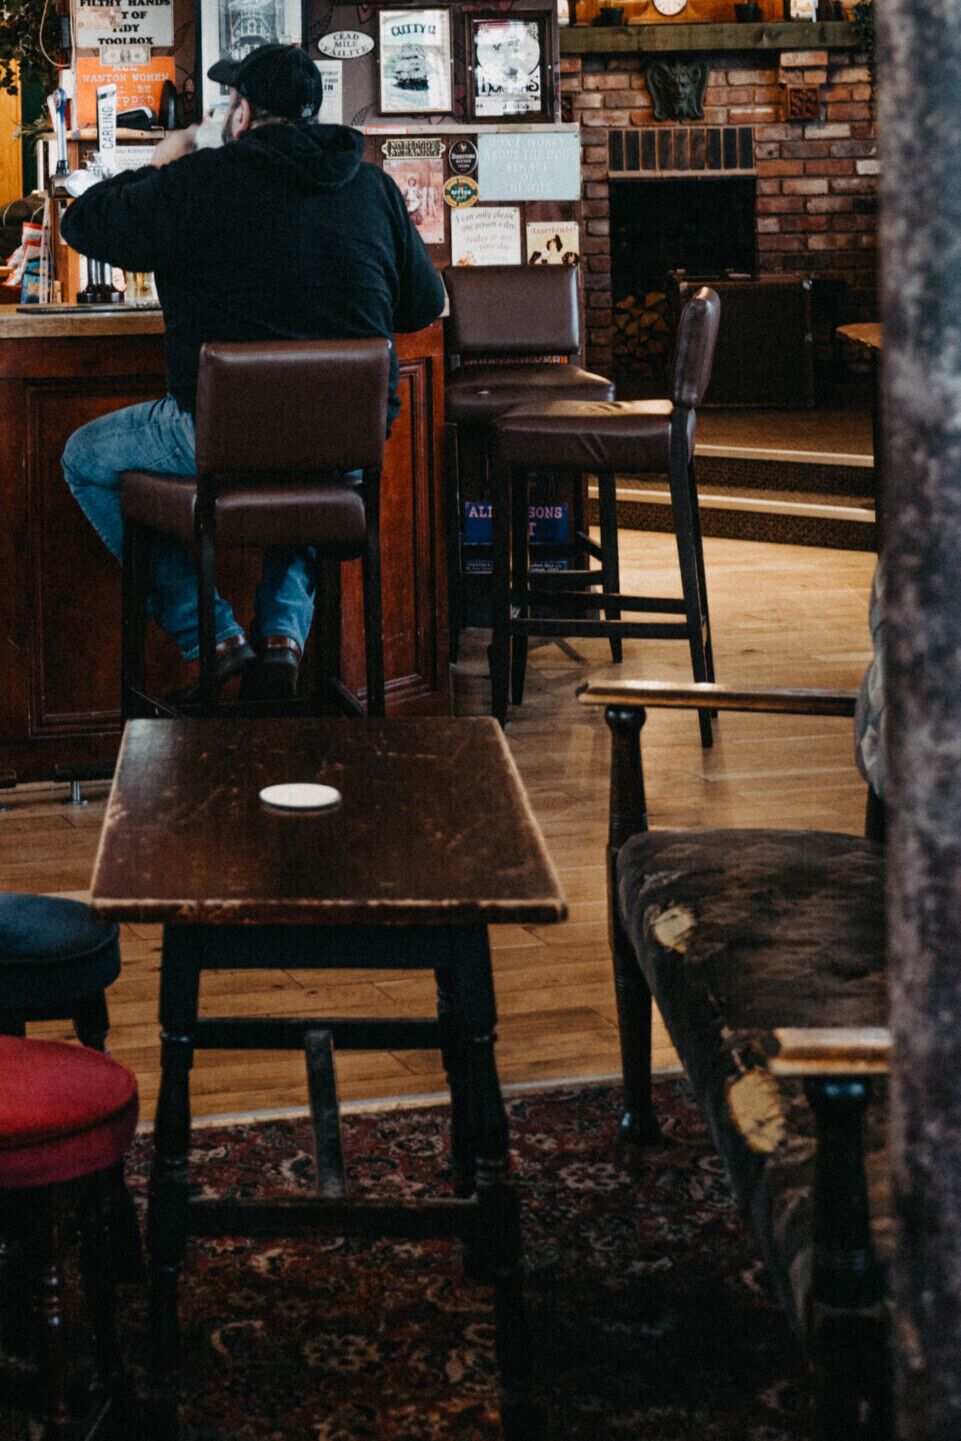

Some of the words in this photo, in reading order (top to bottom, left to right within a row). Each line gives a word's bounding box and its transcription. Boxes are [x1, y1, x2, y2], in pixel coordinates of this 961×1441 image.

[131, 11, 148, 20] OF
[390, 23, 426, 37] CUTTY
[97, 36, 154, 45] TOOLBOX
[82, 73, 127, 83] WANTON
[132, 72, 170, 82] WOMEN
[102, 105, 114, 150] CARLING
